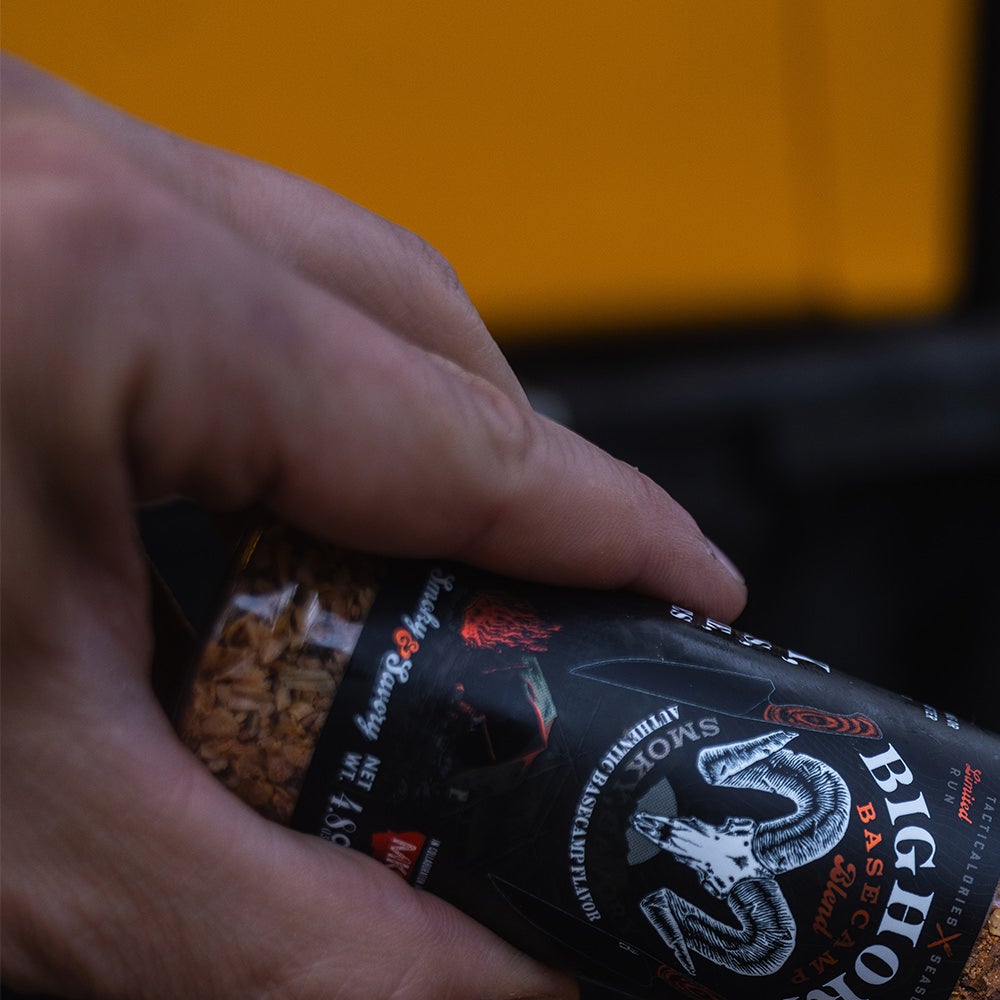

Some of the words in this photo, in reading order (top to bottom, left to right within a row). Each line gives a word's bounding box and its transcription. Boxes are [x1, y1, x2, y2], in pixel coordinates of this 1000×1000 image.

[401, 568, 454, 640] Smoky
[392, 626, 420, 660] &
[354, 650, 412, 741] Savory
[338, 751, 362, 781] WT.
[358, 752, 382, 791] NET
[601, 705, 680, 773] AUTHENTIC
[570, 768, 609, 864] BASECAMP
[944, 767, 961, 805] RUN
[957, 763, 982, 825] Limited
[571, 865, 602, 922] FLAVOR
[791, 802, 885, 985] BASECAMP
[812, 853, 857, 939] Blend
[946, 796, 997, 928] TACTICALORIES
